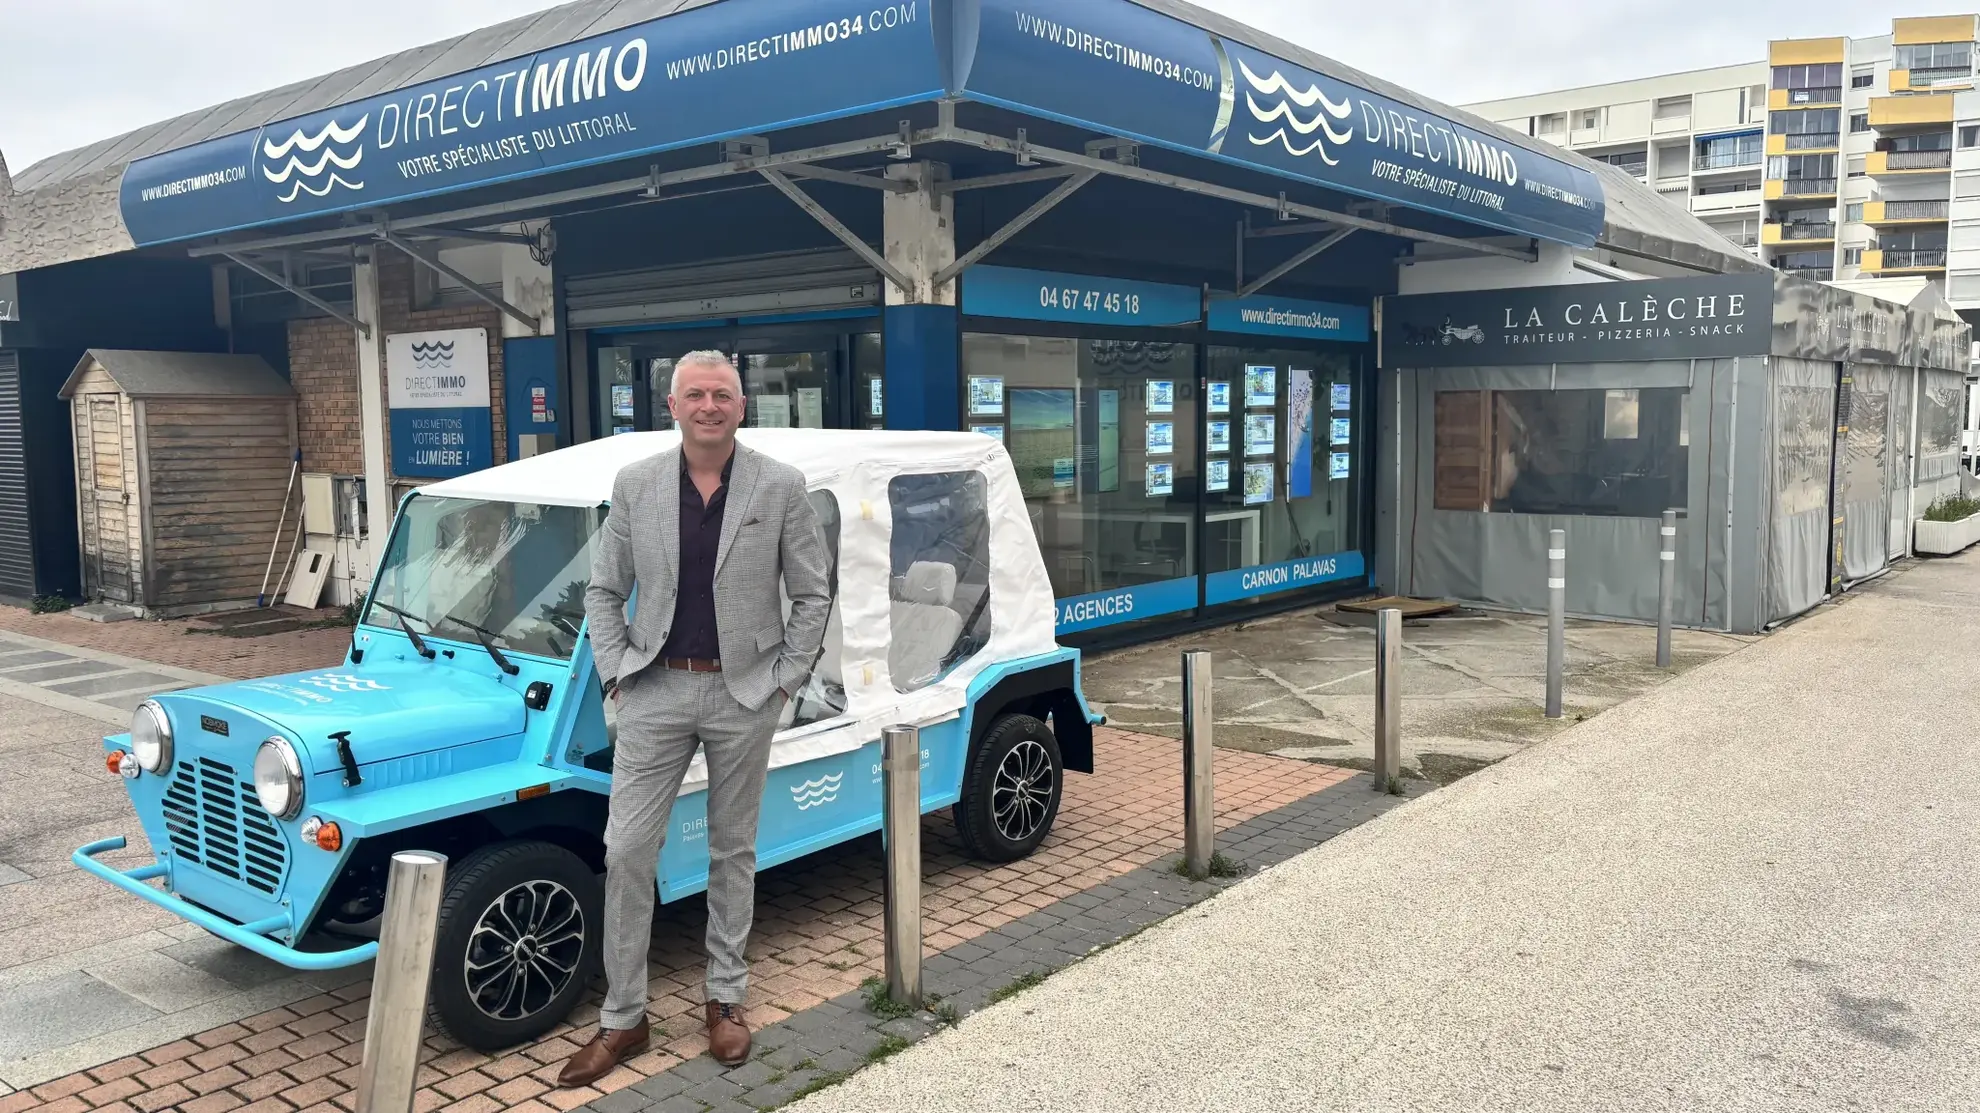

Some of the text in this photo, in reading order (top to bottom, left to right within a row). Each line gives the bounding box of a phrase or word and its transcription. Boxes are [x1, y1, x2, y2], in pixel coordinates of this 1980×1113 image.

[666, 1, 917, 80] WWW.DIRECTIMMO34.COM
[1015, 10, 1213, 92] WWW.DIRECTIMMO34.COM
[377, 37, 648, 149] DIRECTIMMO
[397, 111, 637, 179] VOTRE SPÉCIALISTE DU LITTORAL
[1359, 99, 1518, 187] DIRECTIMMO
[141, 165, 247, 202] WWW.DIRECTIMMO34.COM
[1371, 158, 1506, 212] VOTRE SPÉCIALISTE DU LITTORAL
[1040, 286, 1140, 315] 04 67 47 45 18
[1504, 293, 1746, 329] LA CALÈCHE
[1241, 307, 1340, 330] www.directimmo34.com
[1503, 332, 1575, 345] TRAITEUR
[1598, 327, 1672, 341] PIZZERIA
[1689, 323, 1744, 337] SNACK
[405, 375, 466, 390] DIRECTIMMO
[412, 418, 463, 429] NOUS METTONS
[412, 432, 464, 445] VOTRE BIEN
[416, 446, 463, 466] LUMIÈRE
[1242, 558, 1336, 590] CARNON PALAVAS
[1063, 593, 1134, 625] AGENCES
[871, 748, 930, 775] 04 18
[682, 816, 708, 834] DIRE
